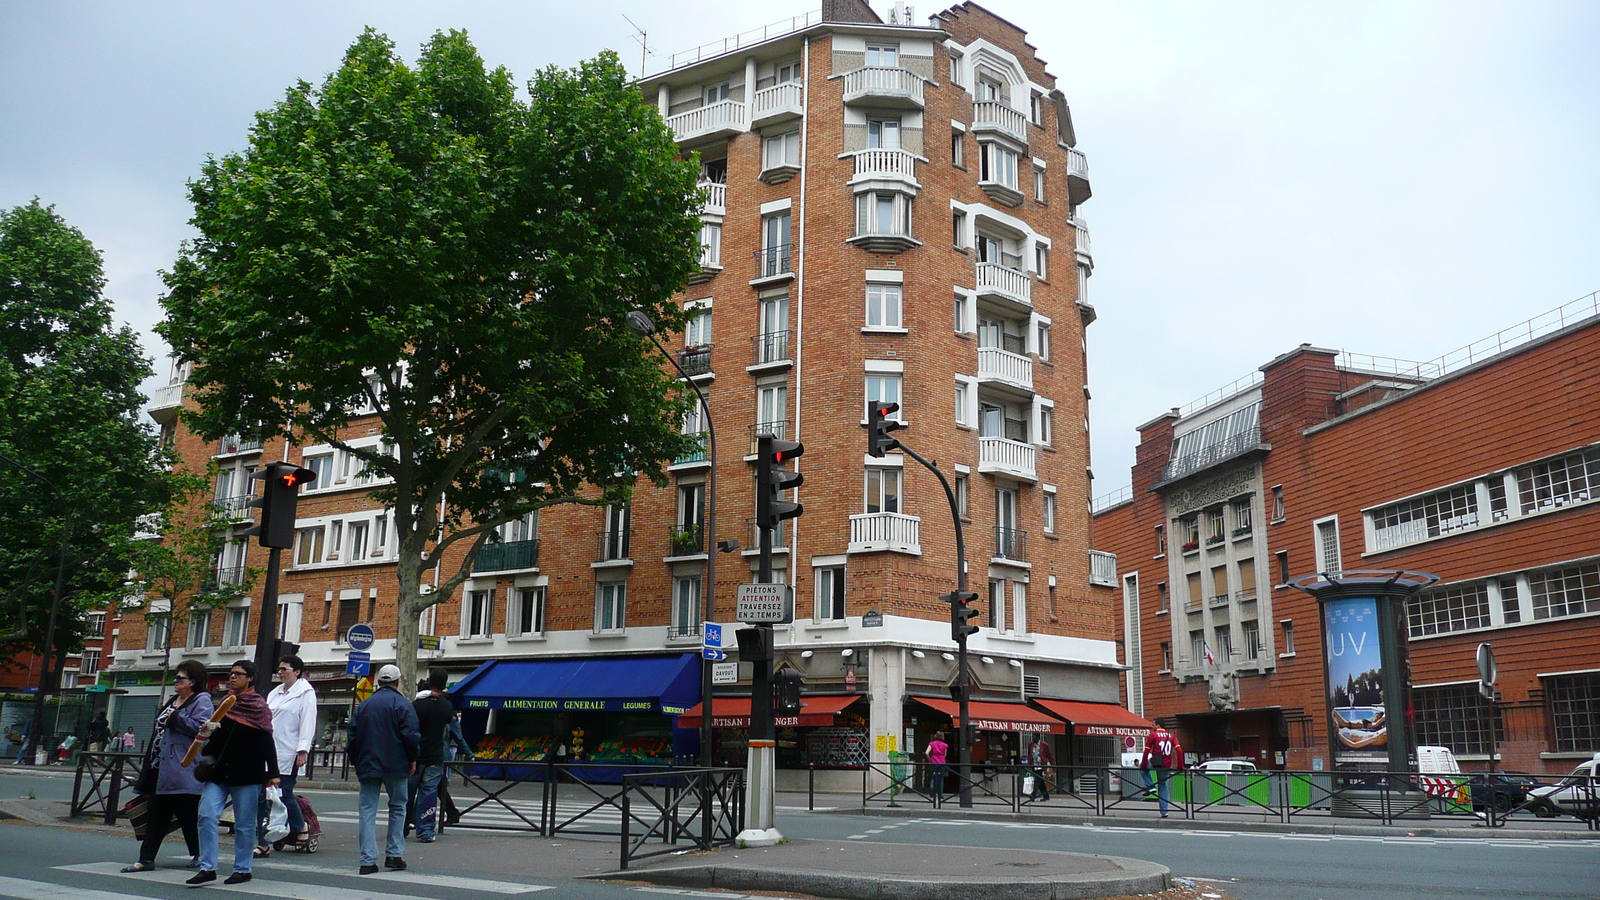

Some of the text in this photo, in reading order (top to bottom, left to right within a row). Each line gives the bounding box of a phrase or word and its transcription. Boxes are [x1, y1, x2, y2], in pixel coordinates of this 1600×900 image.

[1170, 465, 1256, 508] GROUPE SCOLAIRE
[745, 586, 777, 594] PIÉTONS
[738, 611, 782, 619] EN 2 TEMPS
[1331, 632, 1367, 657] UV
[502, 700, 606, 710] ALIMENTATION GENERALE
[978, 720, 1051, 732] ARTISAN BOULANGER
[1086, 726, 1151, 737] ARTISAN BOULANGER
